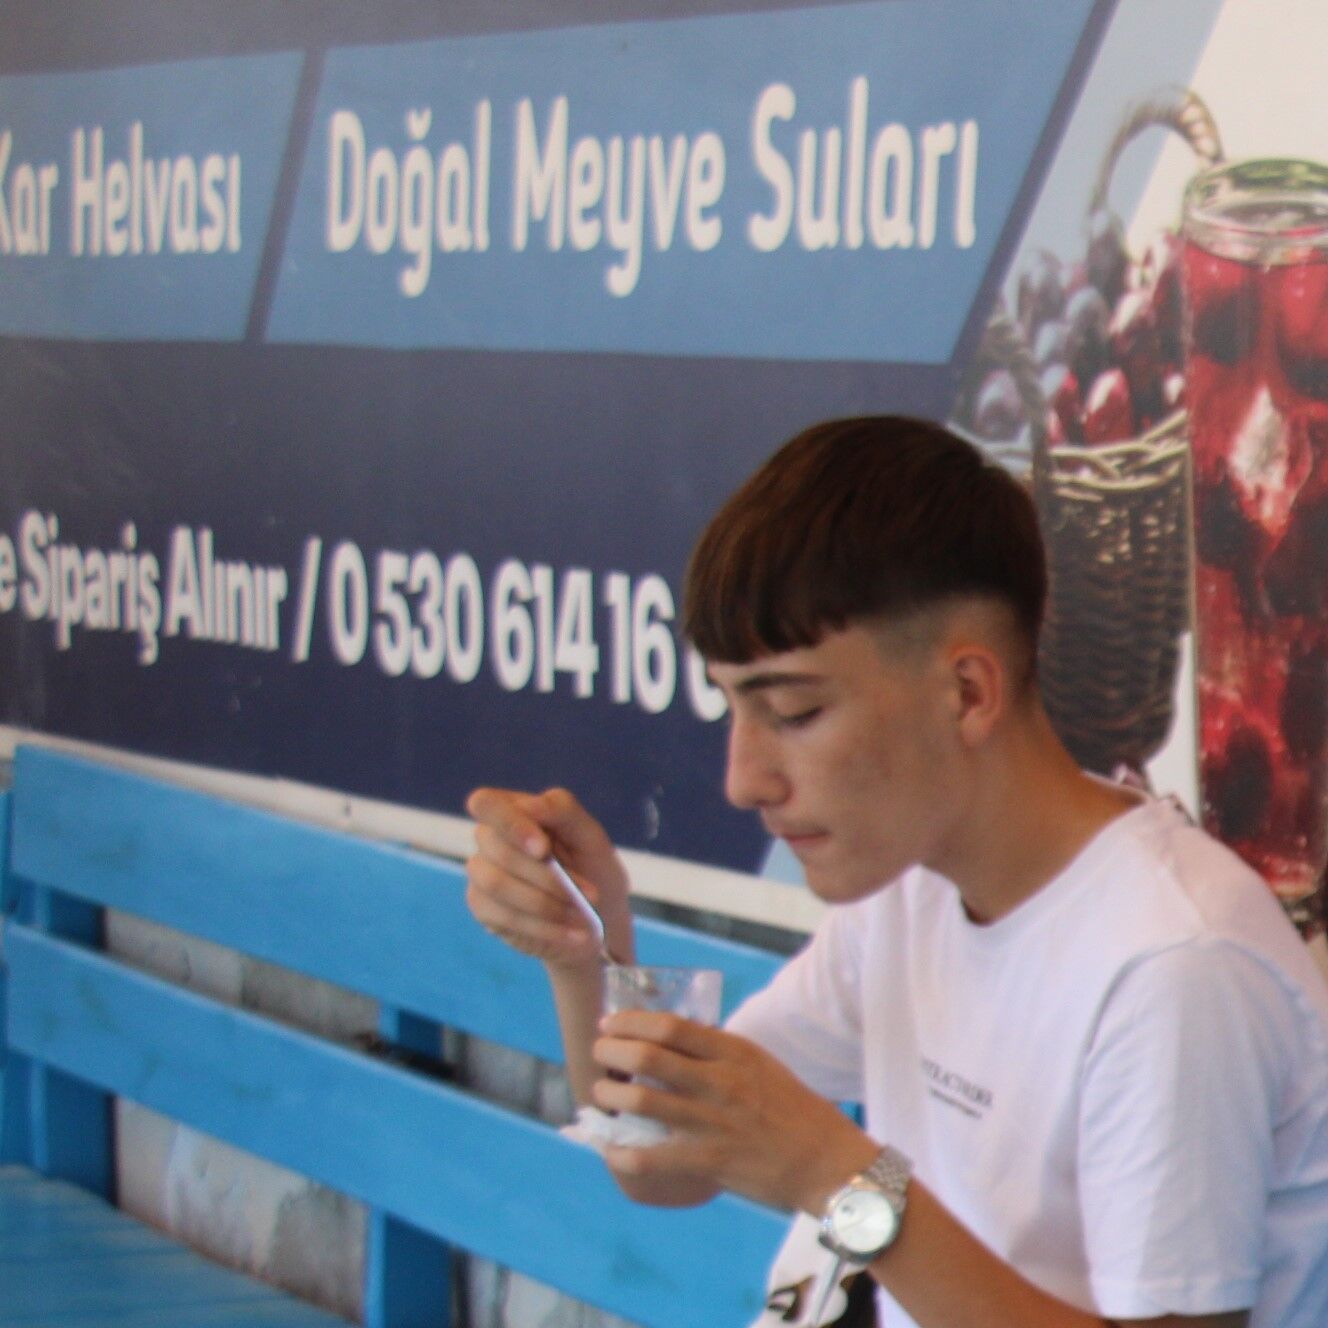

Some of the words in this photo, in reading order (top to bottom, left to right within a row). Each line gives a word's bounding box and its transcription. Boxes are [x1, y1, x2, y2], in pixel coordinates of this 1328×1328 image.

[0, 128, 58, 256] Kar
[72, 119, 242, 257] Helvası
[326, 97, 493, 297] Doğal
[511, 94, 726, 297] Meyve
[747, 75, 981, 251] Suları
[20, 508, 161, 666] Sipariş
[165, 523, 288, 652] Alınır
[374, 547, 484, 683] 530
[492, 558, 600, 698] 614
